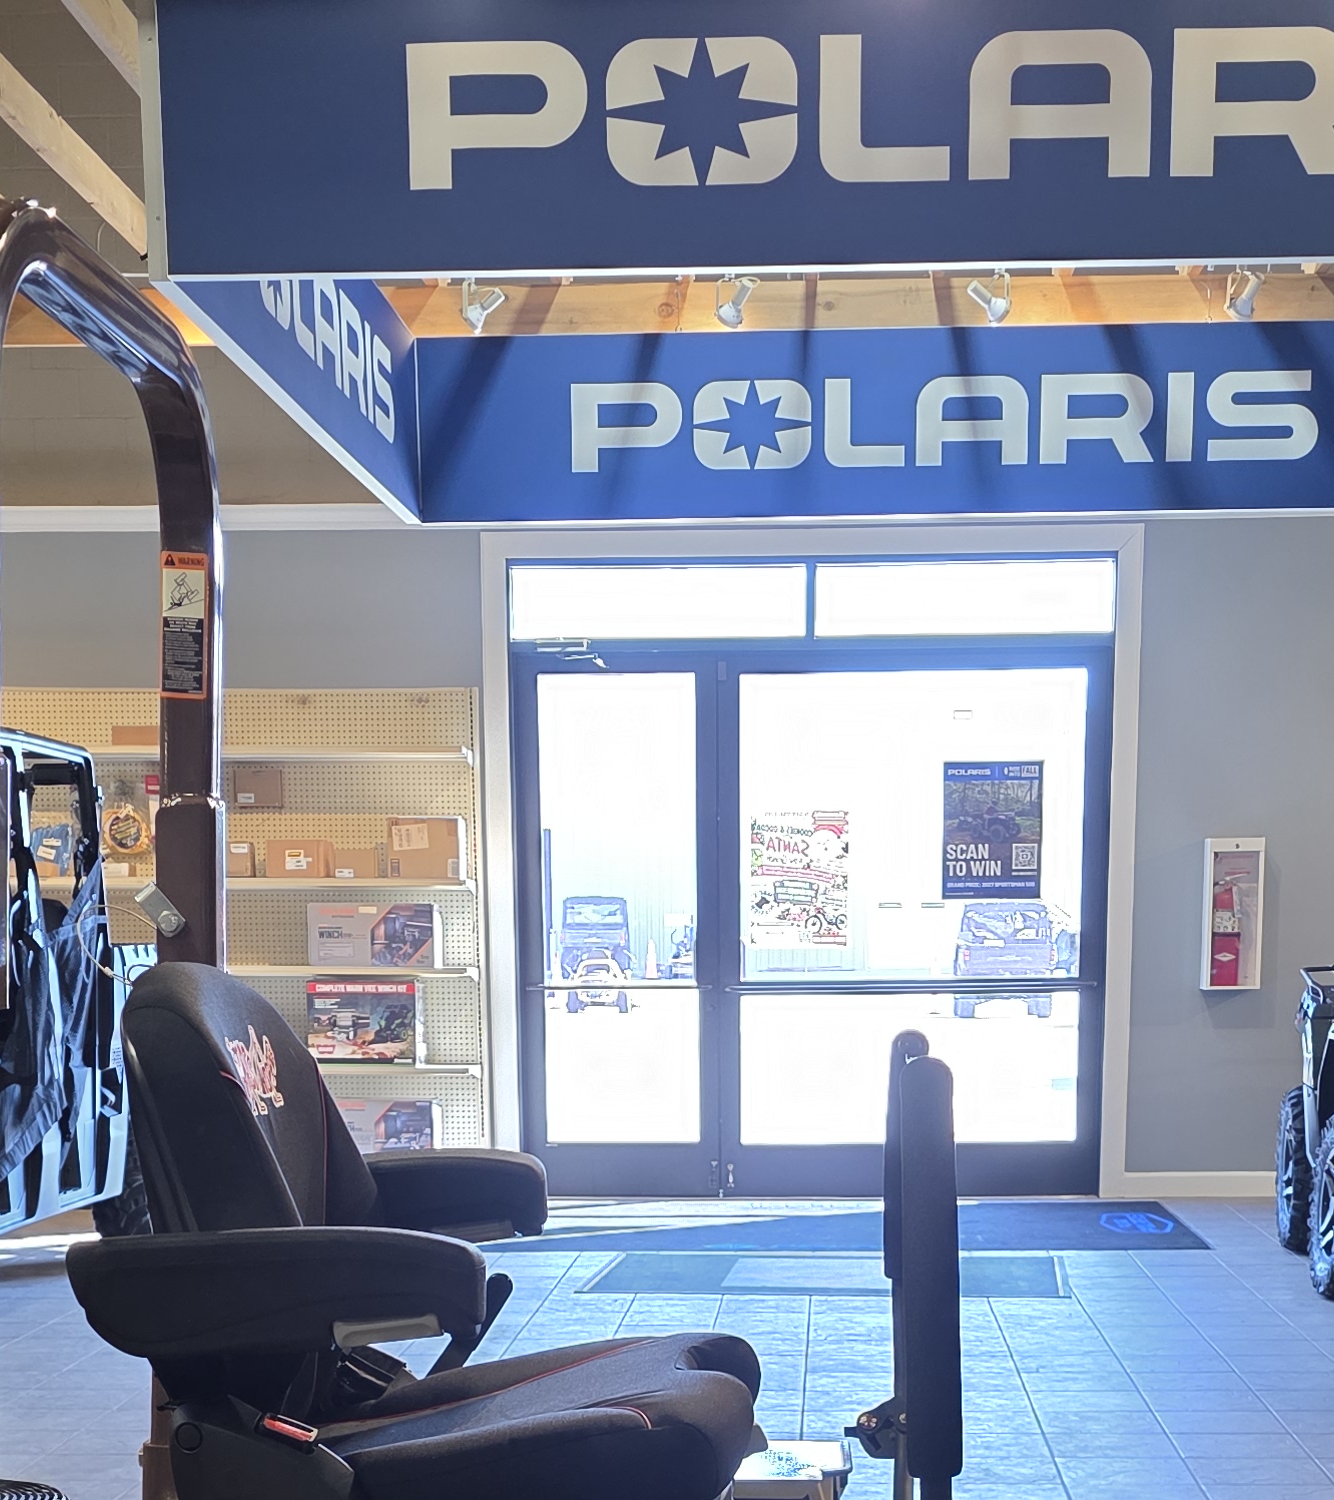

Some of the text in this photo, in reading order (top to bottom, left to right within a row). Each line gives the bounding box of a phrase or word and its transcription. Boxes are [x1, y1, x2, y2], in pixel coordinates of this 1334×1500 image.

[570, 371, 1319, 473] POLARIS
[177, 556, 205, 567] WARNING
[947, 768, 991, 776] POLARIS
[946, 843, 989, 859] SCAN
[946, 860, 1002, 876] TO WIN
